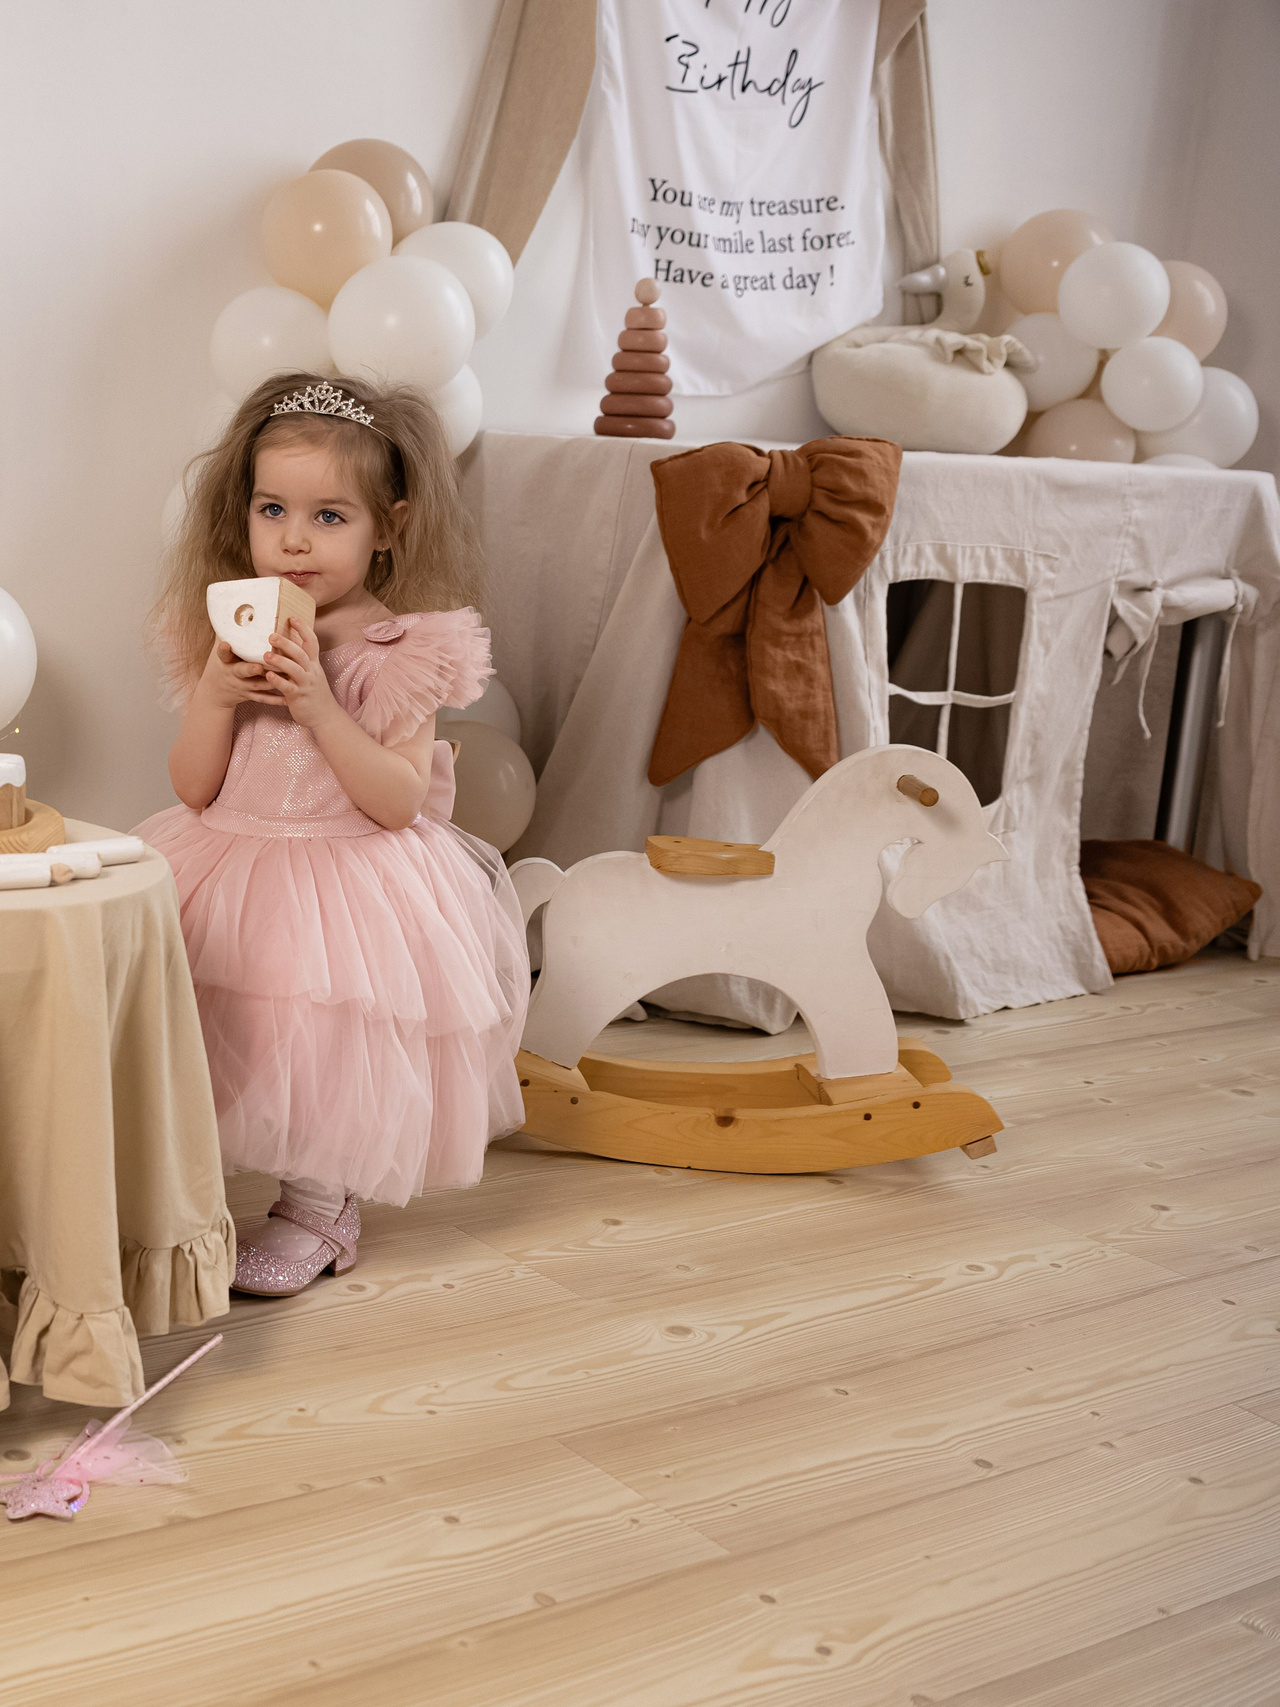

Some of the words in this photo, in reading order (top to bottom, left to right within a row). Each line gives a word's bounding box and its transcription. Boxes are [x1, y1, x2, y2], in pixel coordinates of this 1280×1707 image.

[665, 34, 825, 129] Birthday
[649, 178, 693, 207] You
[719, 199, 744, 224] my
[750, 195, 845, 217] treasure.
[656, 225, 710, 250] your
[759, 230, 795, 254] last
[654, 258, 715, 288] Have
[721, 274, 730, 289] a
[733, 271, 776, 298] great
[782, 266, 821, 296] day
